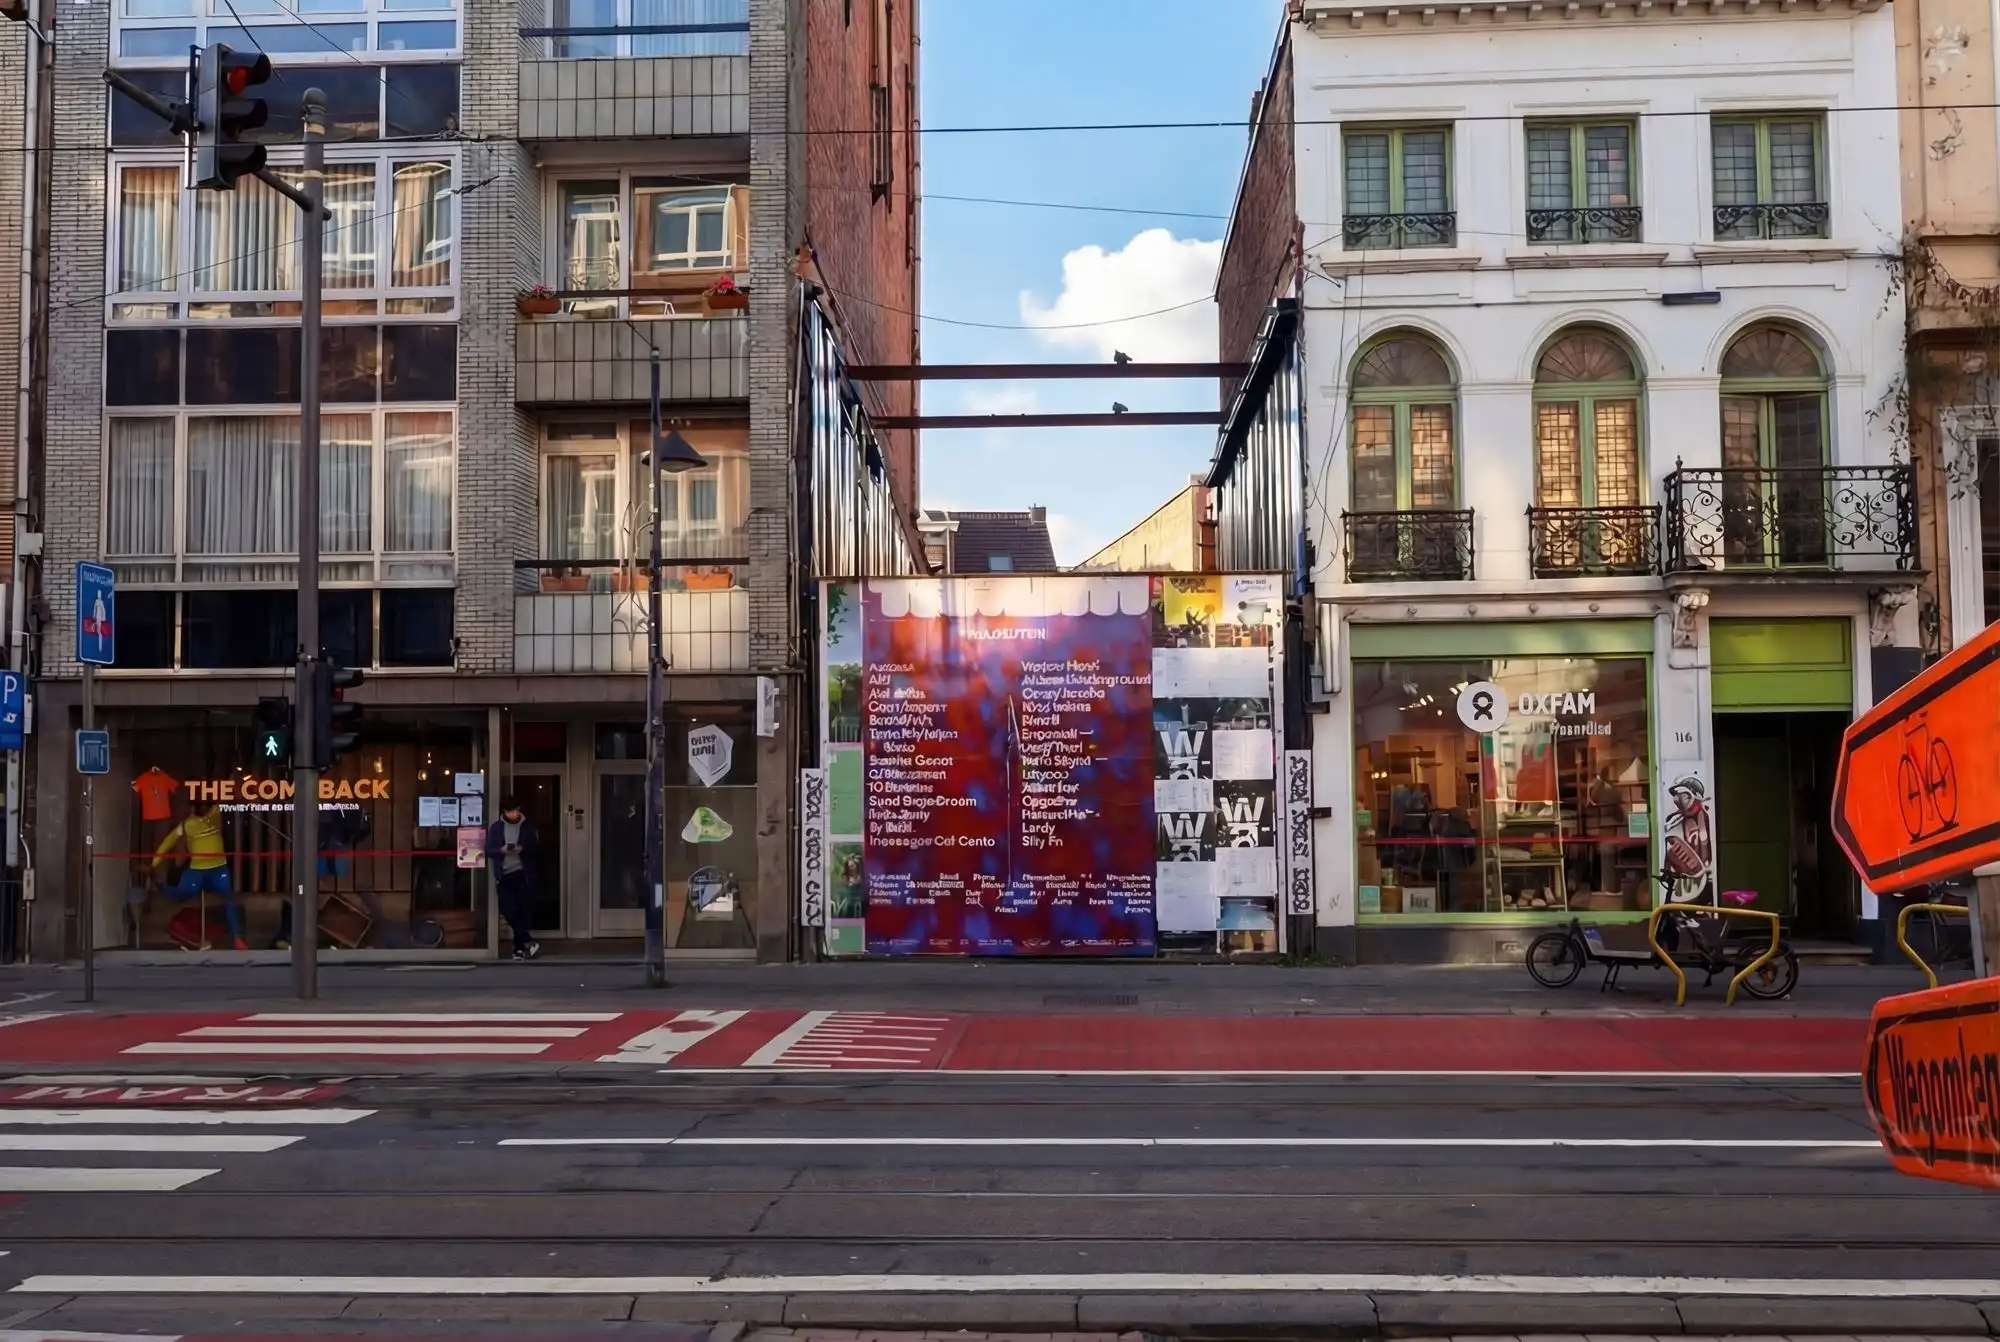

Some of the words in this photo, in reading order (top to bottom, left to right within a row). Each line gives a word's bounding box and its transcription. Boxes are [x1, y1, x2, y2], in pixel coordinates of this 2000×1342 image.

[4, 675, 17, 704] P
[1518, 692, 1596, 715] OXFAM
[185, 780, 235, 801] THE
[241, 778, 390, 800] COMBACK
[10, 1086, 319, 1101] TRAM
